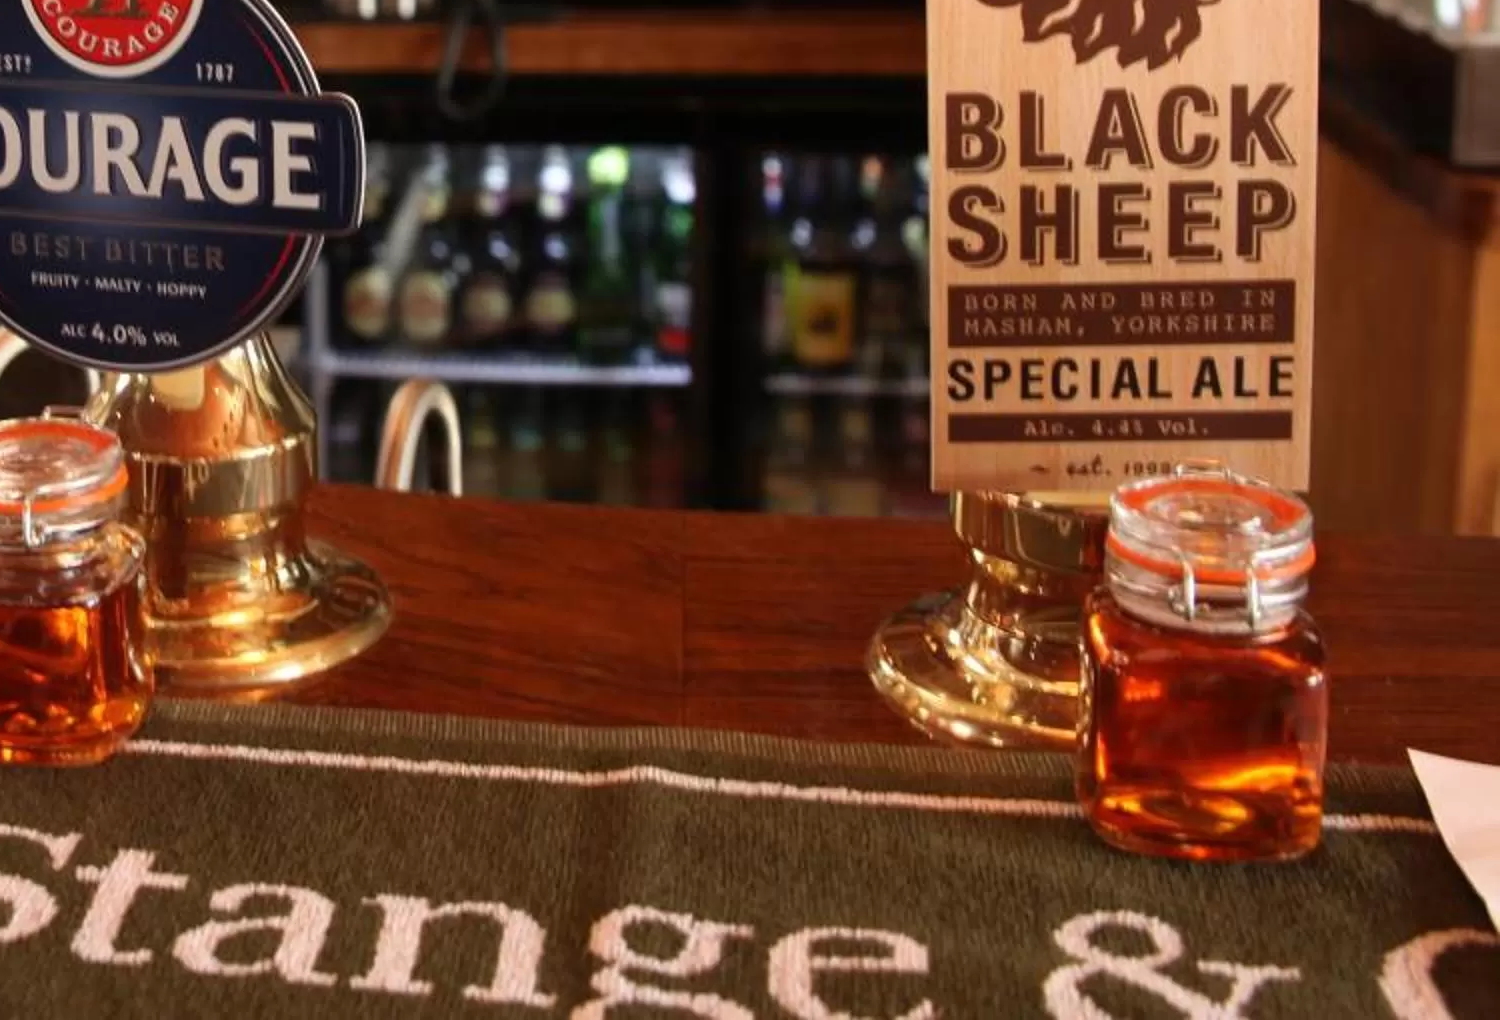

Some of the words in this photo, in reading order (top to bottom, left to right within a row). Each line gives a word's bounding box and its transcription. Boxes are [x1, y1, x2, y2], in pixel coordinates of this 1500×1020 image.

[196, 62, 235, 83] 1787
[945, 83, 1297, 174] BLACK
[946, 180, 1297, 267] SHEEP
[10, 231, 92, 261] BEST
[105, 236, 225, 272] BITTER
[31, 271, 80, 290] FRUITY
[94, 276, 142, 294] MALTY
[157, 282, 207, 303] HOPPY
[964, 292, 1037, 312] BORN
[1060, 292, 1116, 311] AND
[1140, 291, 1215, 310] BRED
[1242, 289, 1276, 307] IN
[92, 323, 147, 347] 4.0%
[153, 331, 181, 348] VOL
[964, 315, 1086, 338] MASHAM,
[1111, 313, 1275, 336] YORKSHIRE
[947, 355, 1173, 402] SPECIAL
[1192, 355, 1294, 400] ALE
[1156, 418, 1210, 437] Vol.
[1043, 910, 1301, 1020] &
